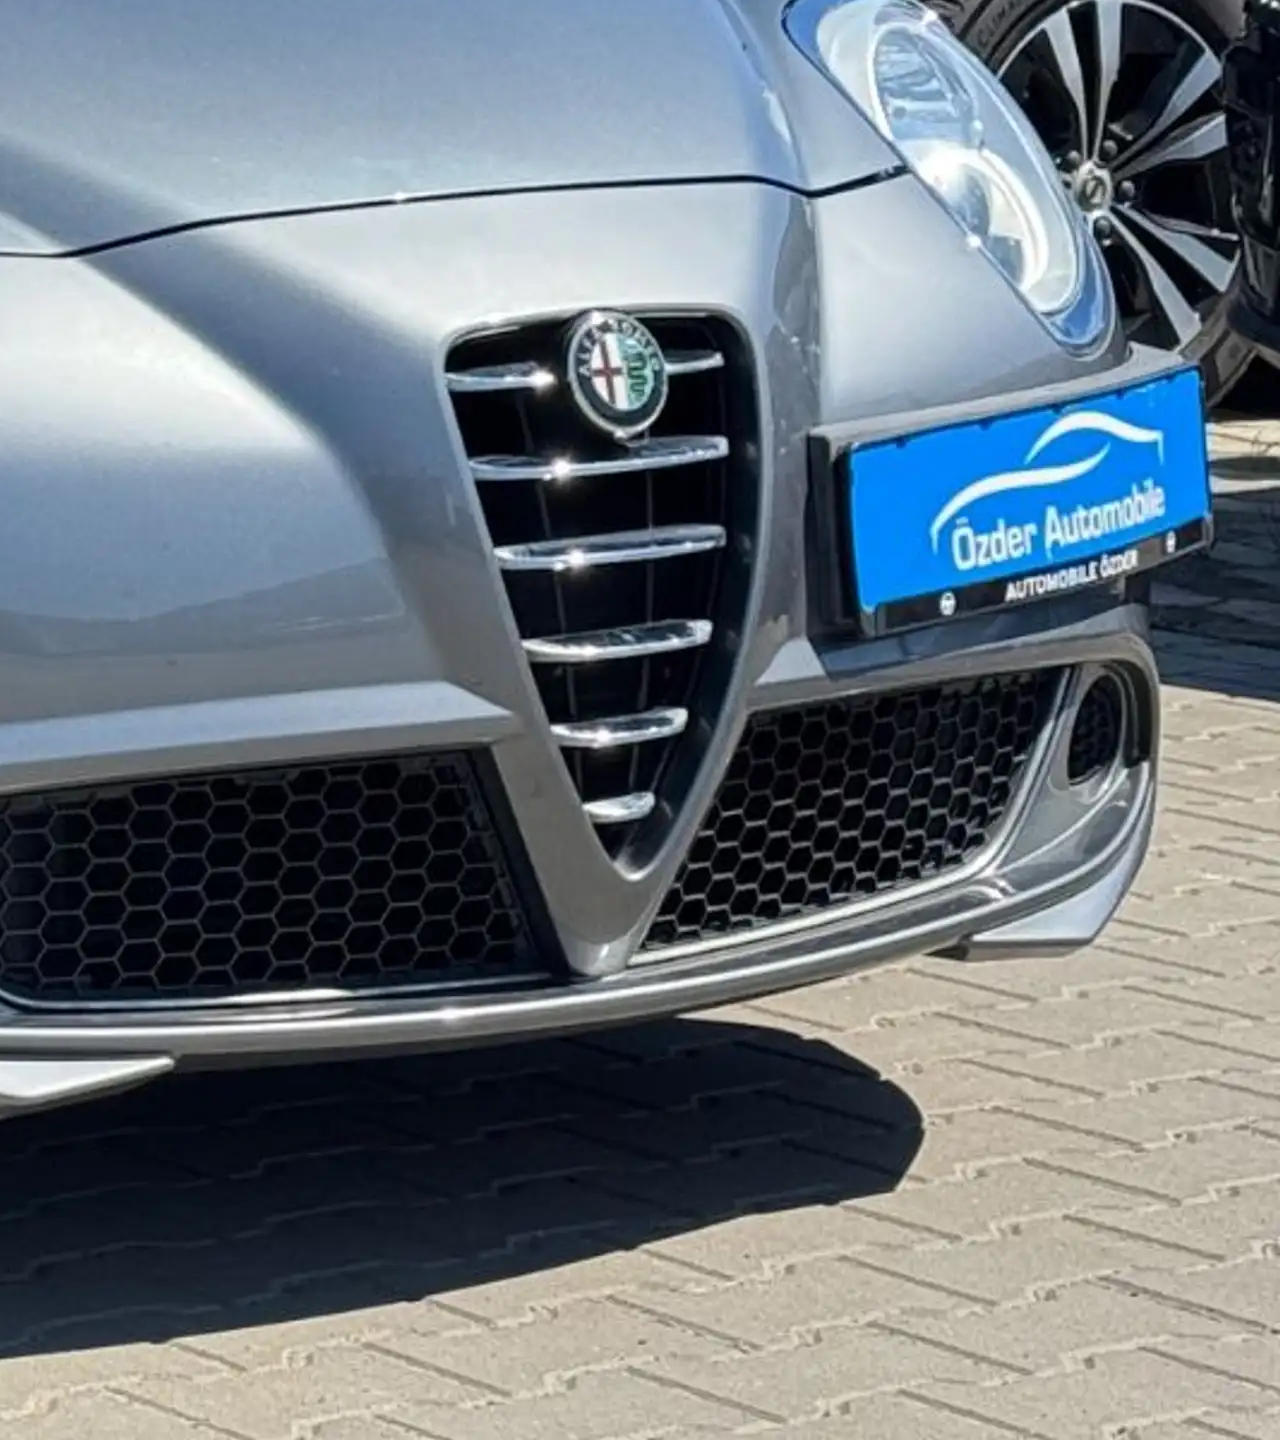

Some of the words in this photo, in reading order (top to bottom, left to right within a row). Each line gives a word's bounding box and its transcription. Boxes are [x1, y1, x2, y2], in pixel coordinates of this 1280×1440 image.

[952, 516, 1038, 572] Özder
[1044, 476, 1166, 561] Automobile
[1005, 560, 1099, 602] AUTOMOBILE
